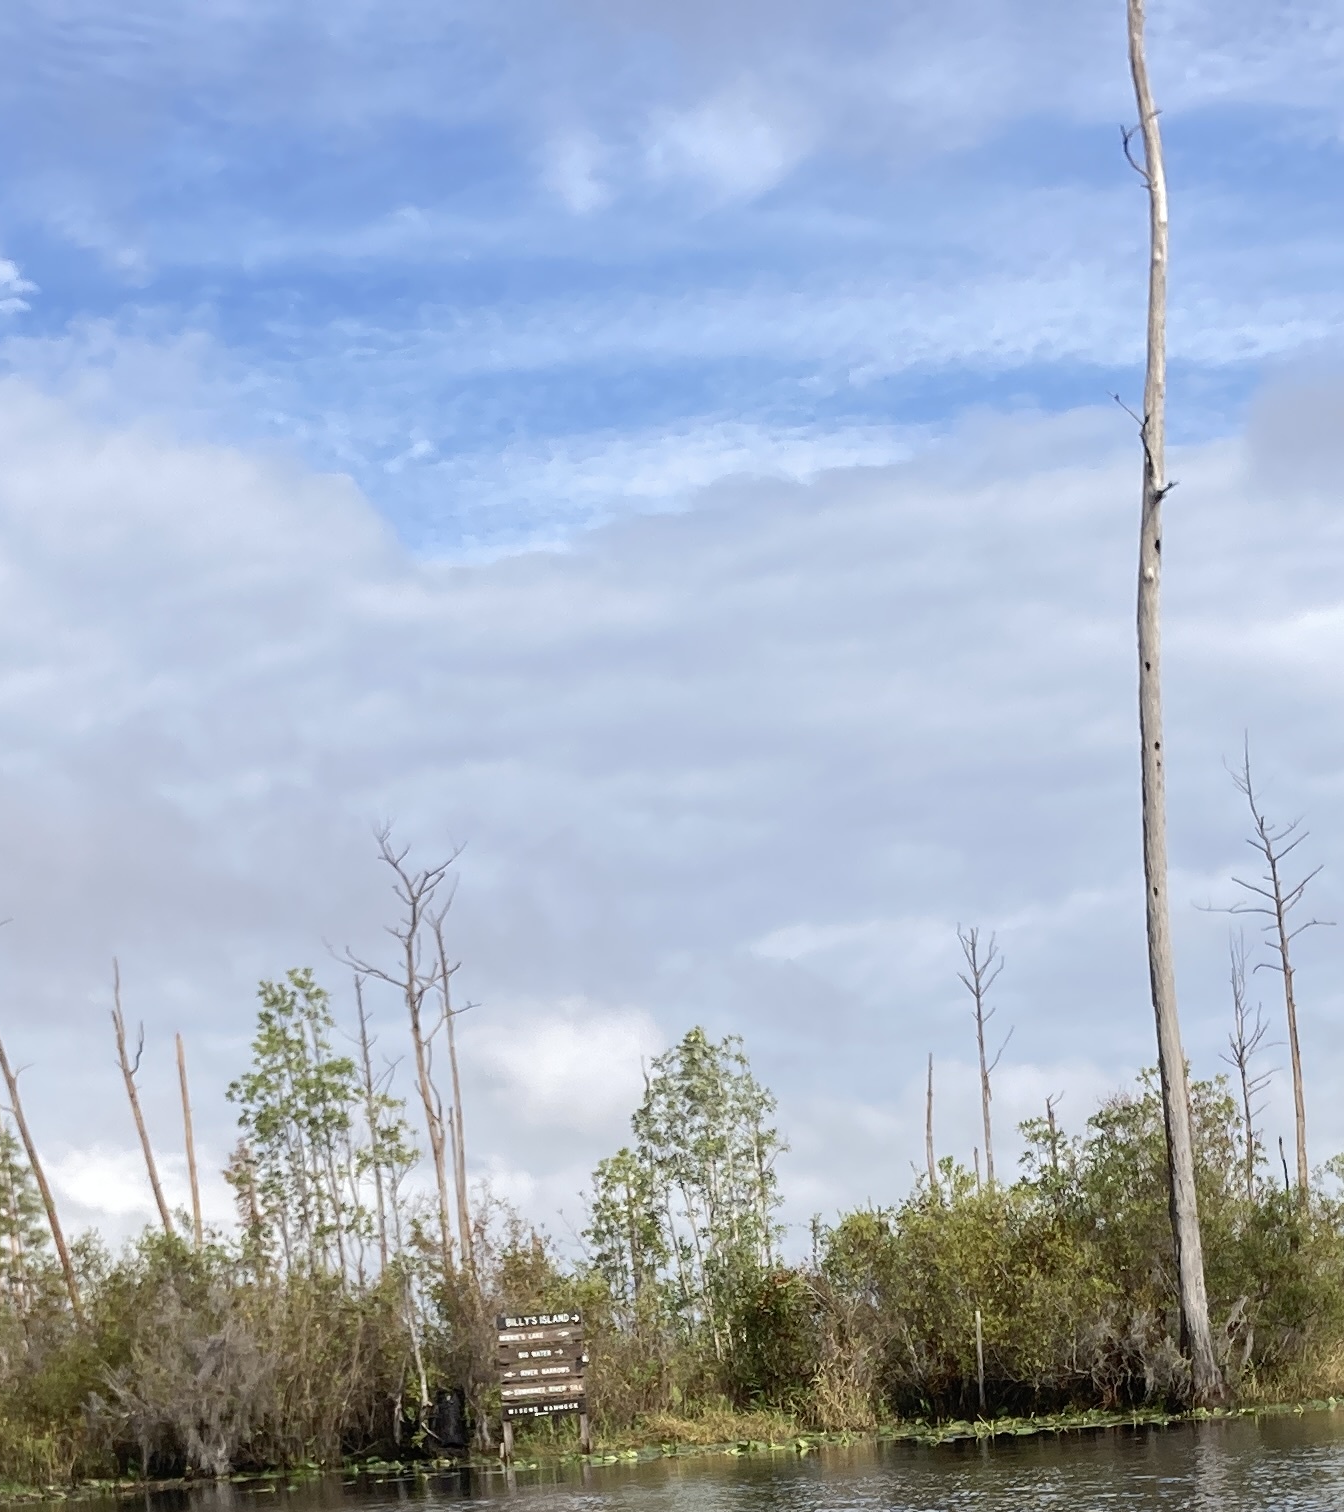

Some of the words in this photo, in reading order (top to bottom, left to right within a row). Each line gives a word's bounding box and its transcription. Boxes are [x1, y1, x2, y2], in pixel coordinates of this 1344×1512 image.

[505, 1316, 537, 1327] BILLY'S
[539, 1314, 570, 1324] ISLAND
[531, 1350, 552, 1358] WATER
